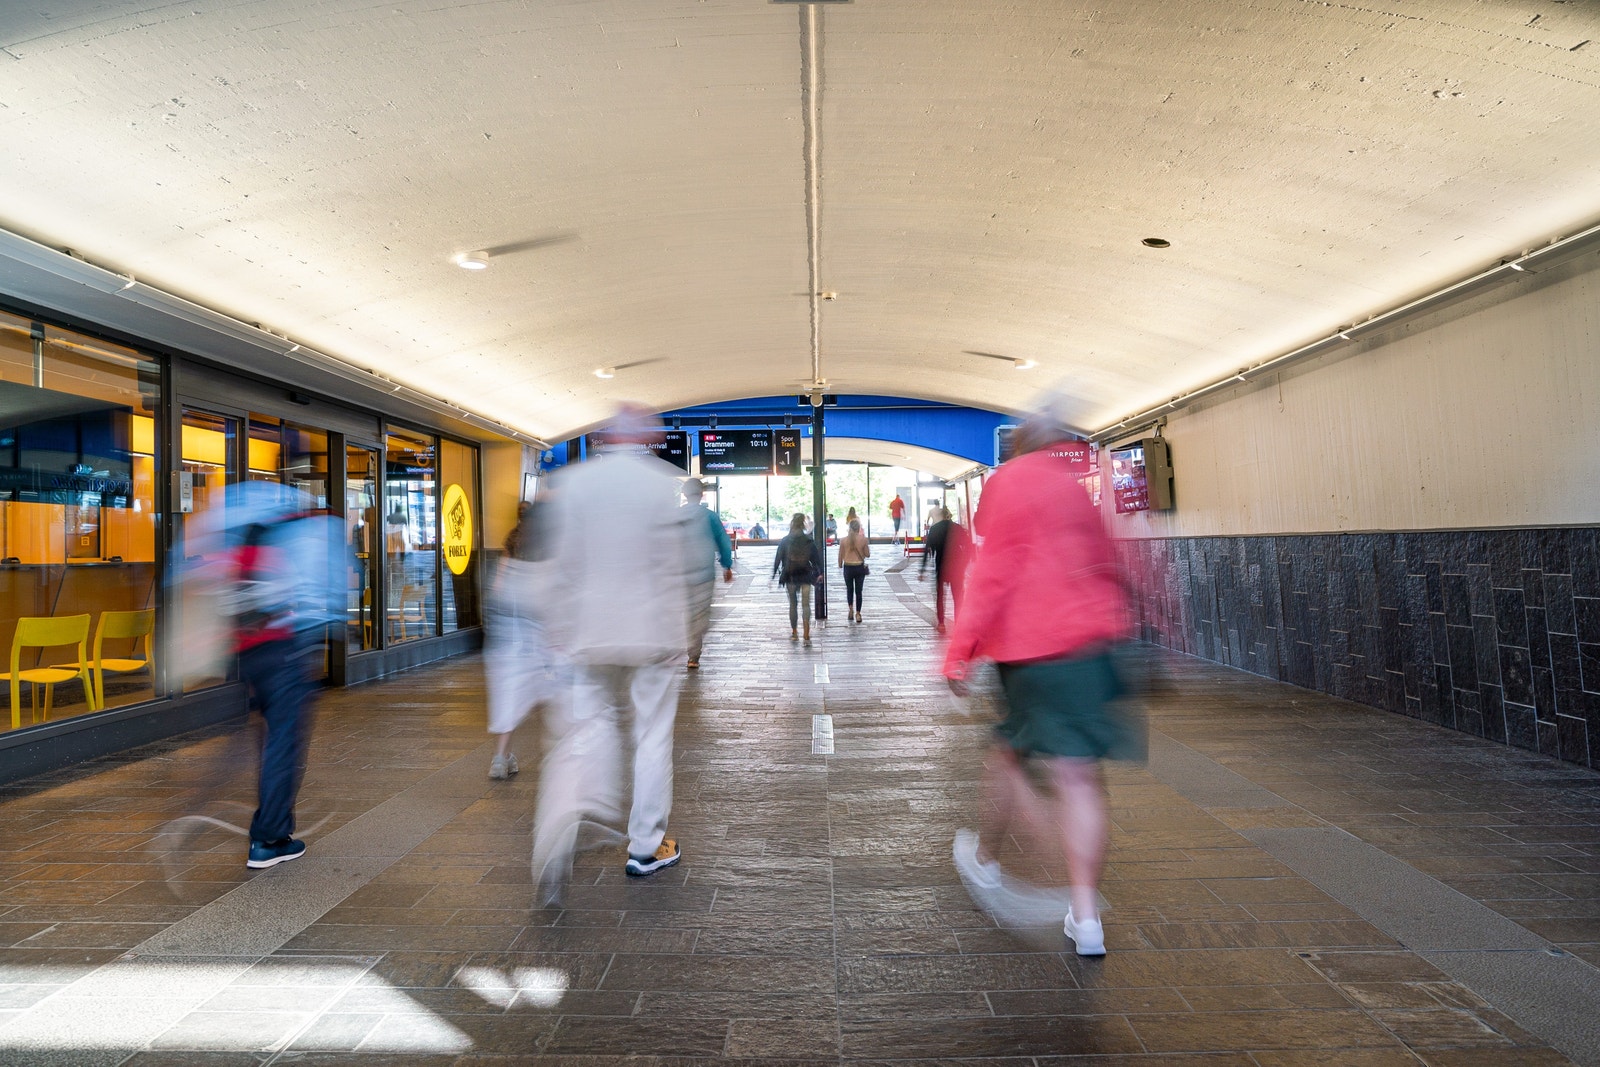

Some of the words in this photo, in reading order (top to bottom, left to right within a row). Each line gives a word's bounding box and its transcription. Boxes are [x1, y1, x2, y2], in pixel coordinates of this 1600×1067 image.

[648, 442, 668, 450] Arrival
[784, 451, 790, 465] 1
[448, 545, 467, 557] FOREX
